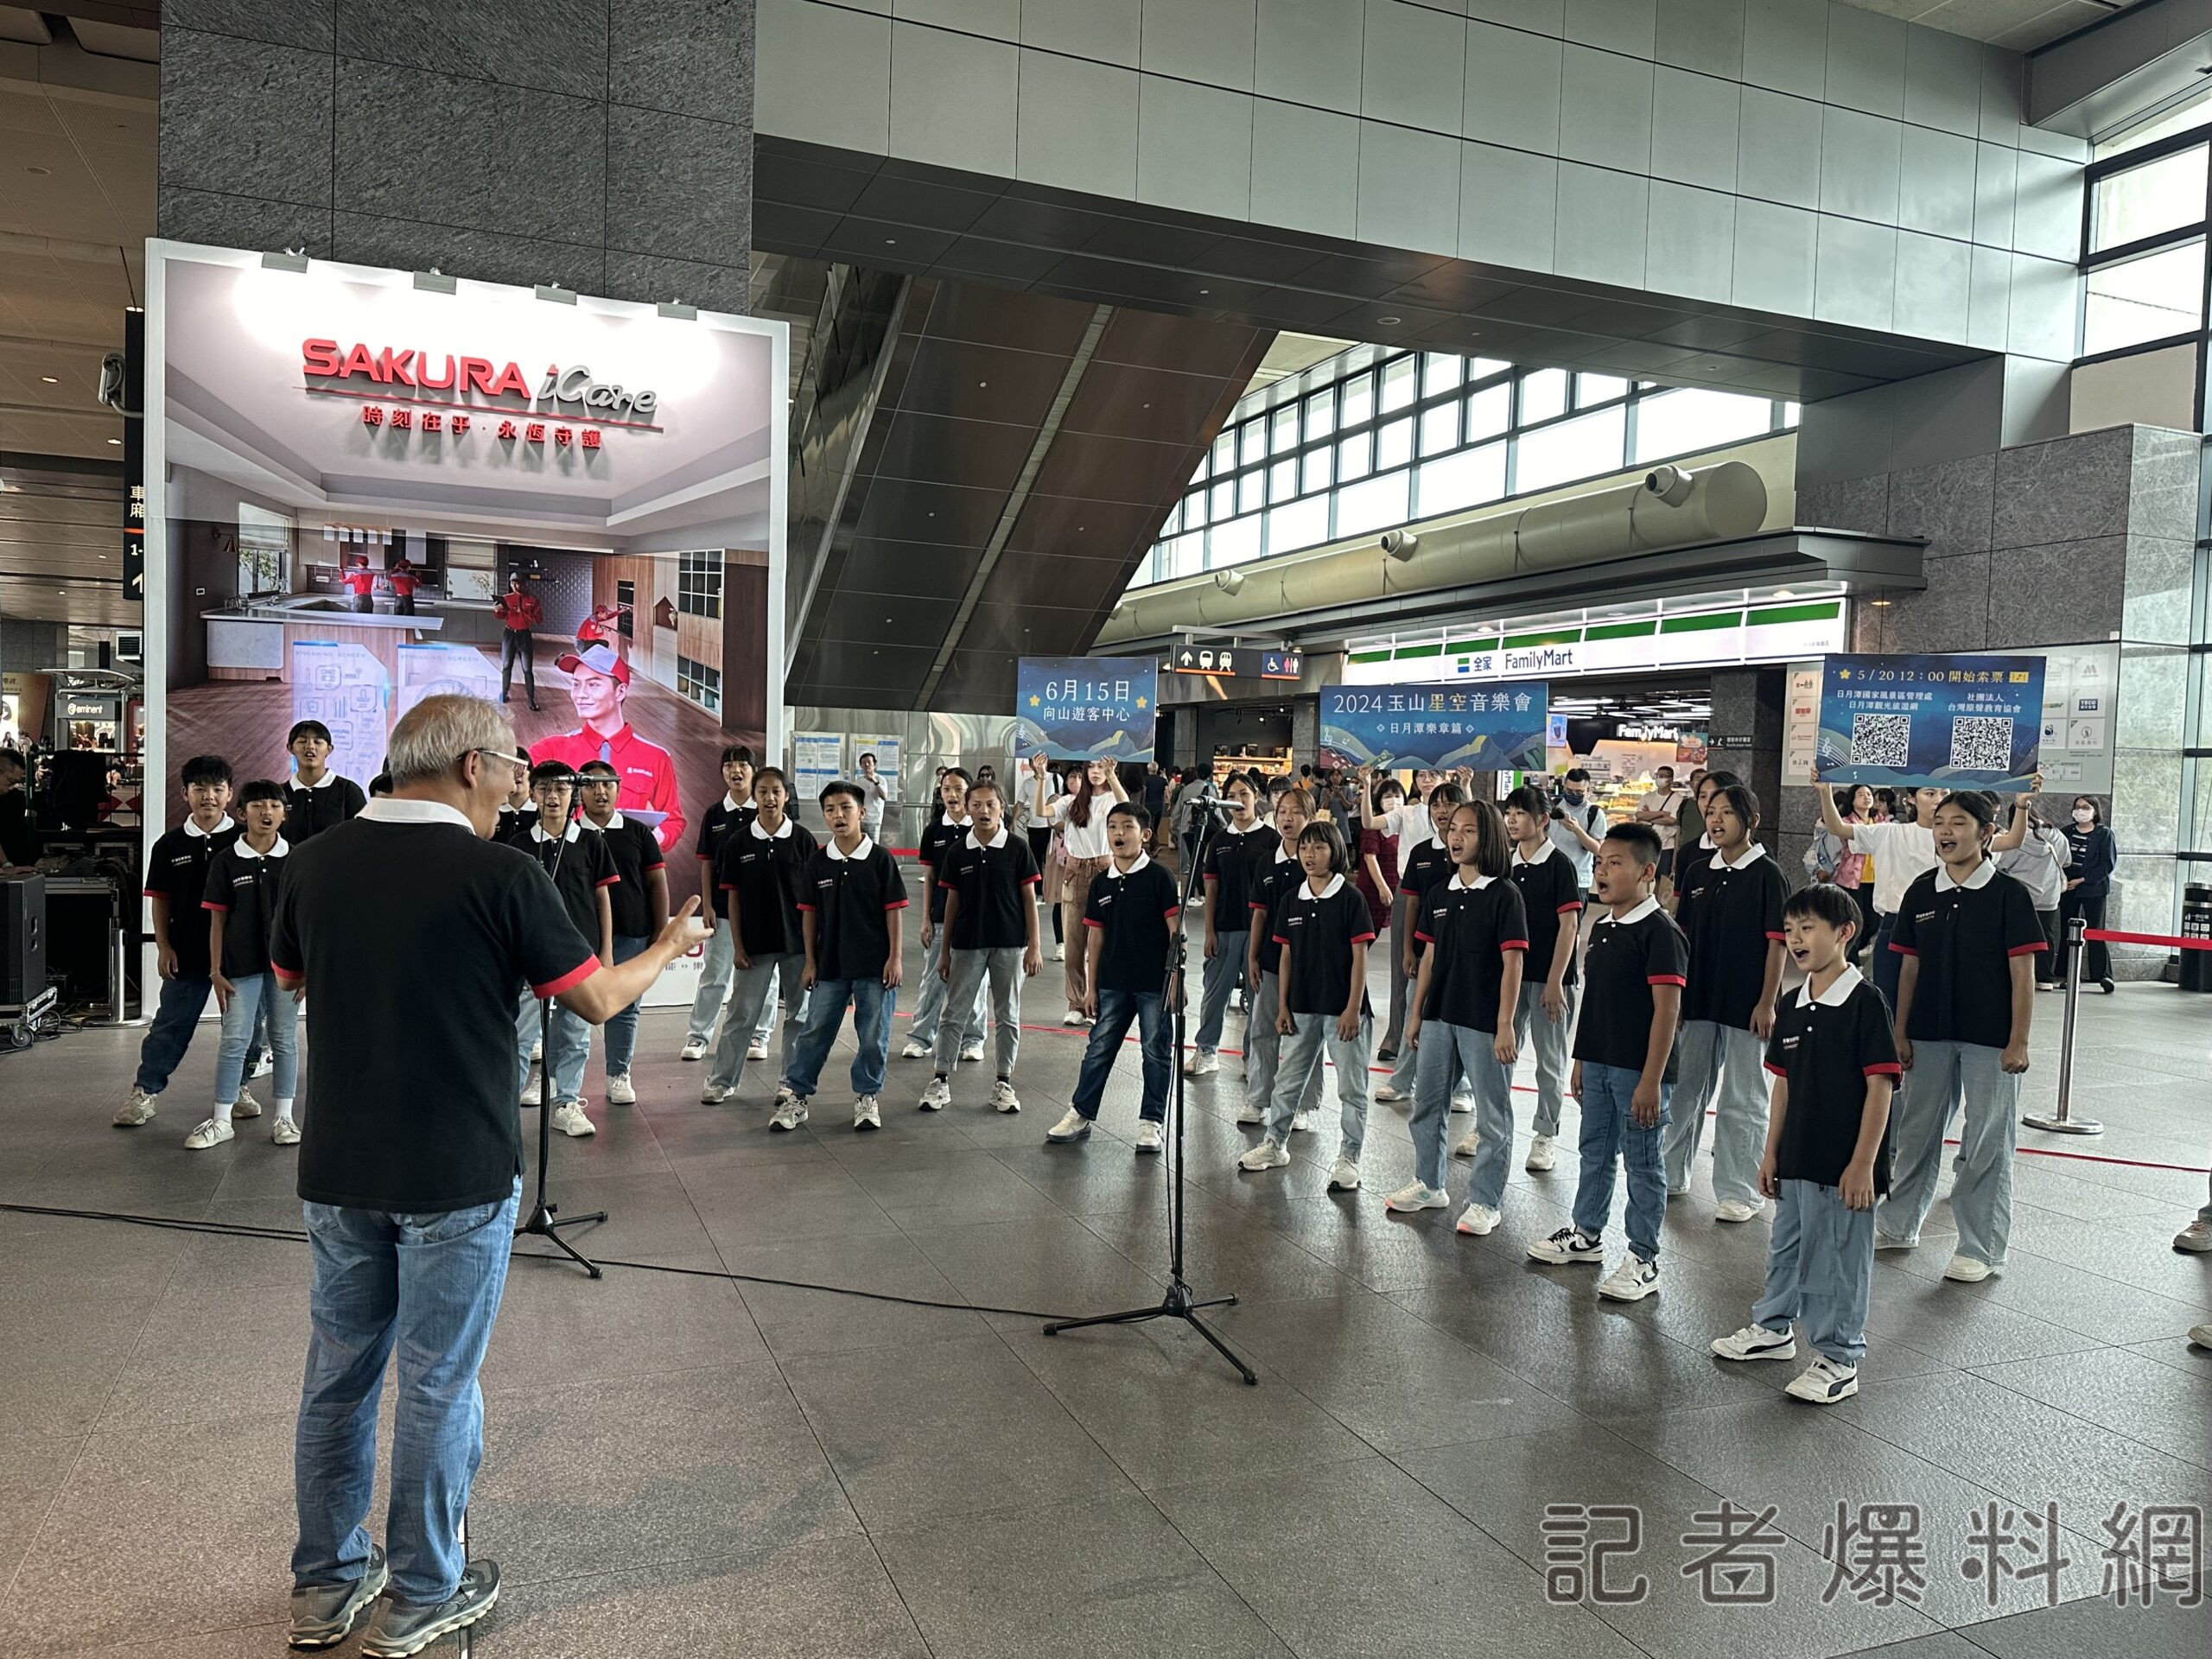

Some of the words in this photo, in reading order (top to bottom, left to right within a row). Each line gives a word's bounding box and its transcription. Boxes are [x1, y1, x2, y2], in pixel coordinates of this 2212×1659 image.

[302, 338, 531, 399] SAKURA
[537, 364, 658, 413] iCare
[1473, 656, 1492, 671] 全家
[1505, 649, 1573, 671] FamilyMart
[1948, 671, 2004, 683] 開始索票
[1046, 679, 1129, 702] 6月15日
[1837, 690, 1933, 701] 日月潭國家風景區管理處
[1967, 693, 2005, 702] 社團法人
[76, 704, 103, 715] eminent
[1043, 706, 1130, 722] 向山遊客中心
[1389, 722, 1462, 734] 日月潭樂章篇
[1618, 724, 1679, 741] FamilyMart
